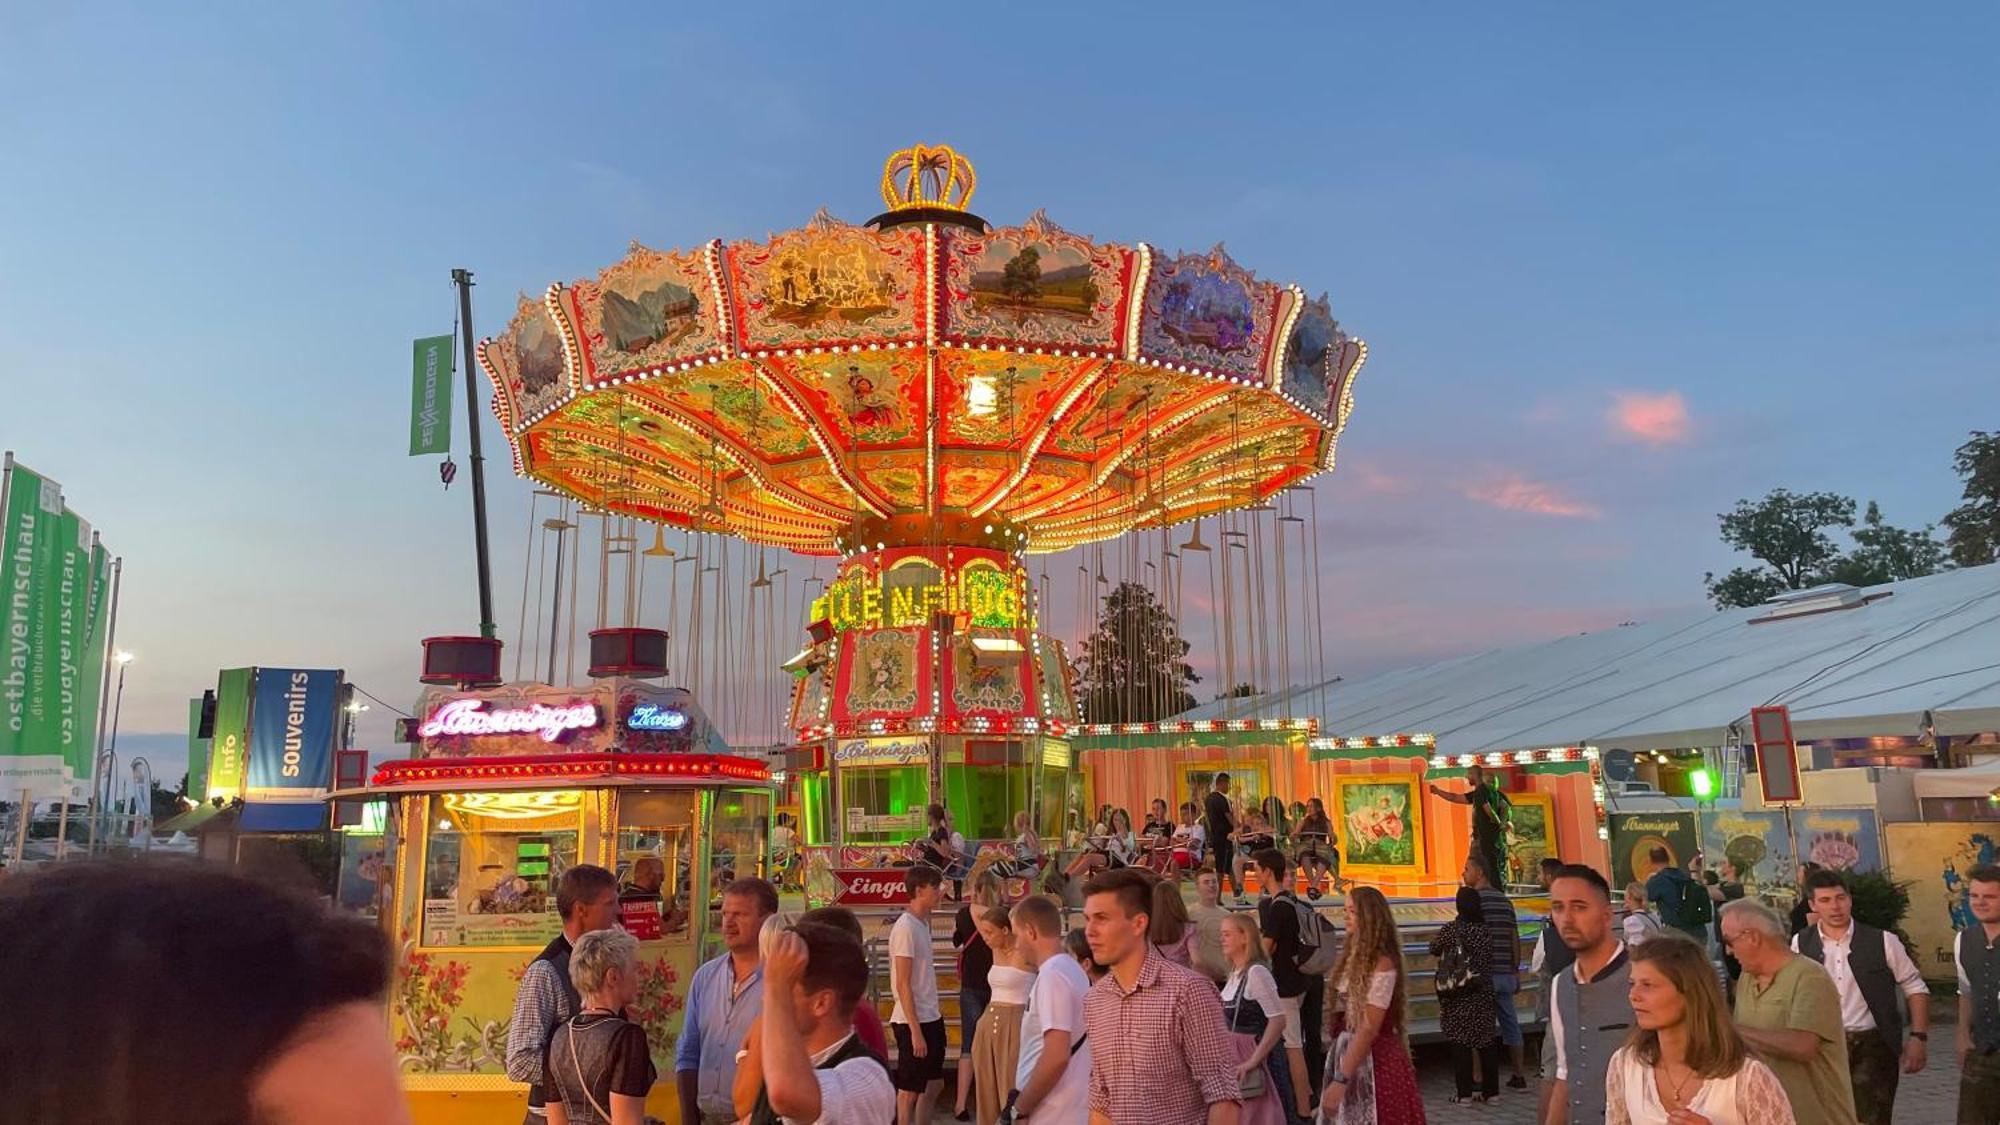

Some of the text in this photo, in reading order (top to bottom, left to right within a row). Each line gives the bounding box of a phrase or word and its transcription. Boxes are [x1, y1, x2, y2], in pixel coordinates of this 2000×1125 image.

[3, 513, 35, 731] ostbayernschau
[219, 735, 235, 775] info
[280, 672, 309, 777] souvenirs
[849, 877, 907, 900] Einga
